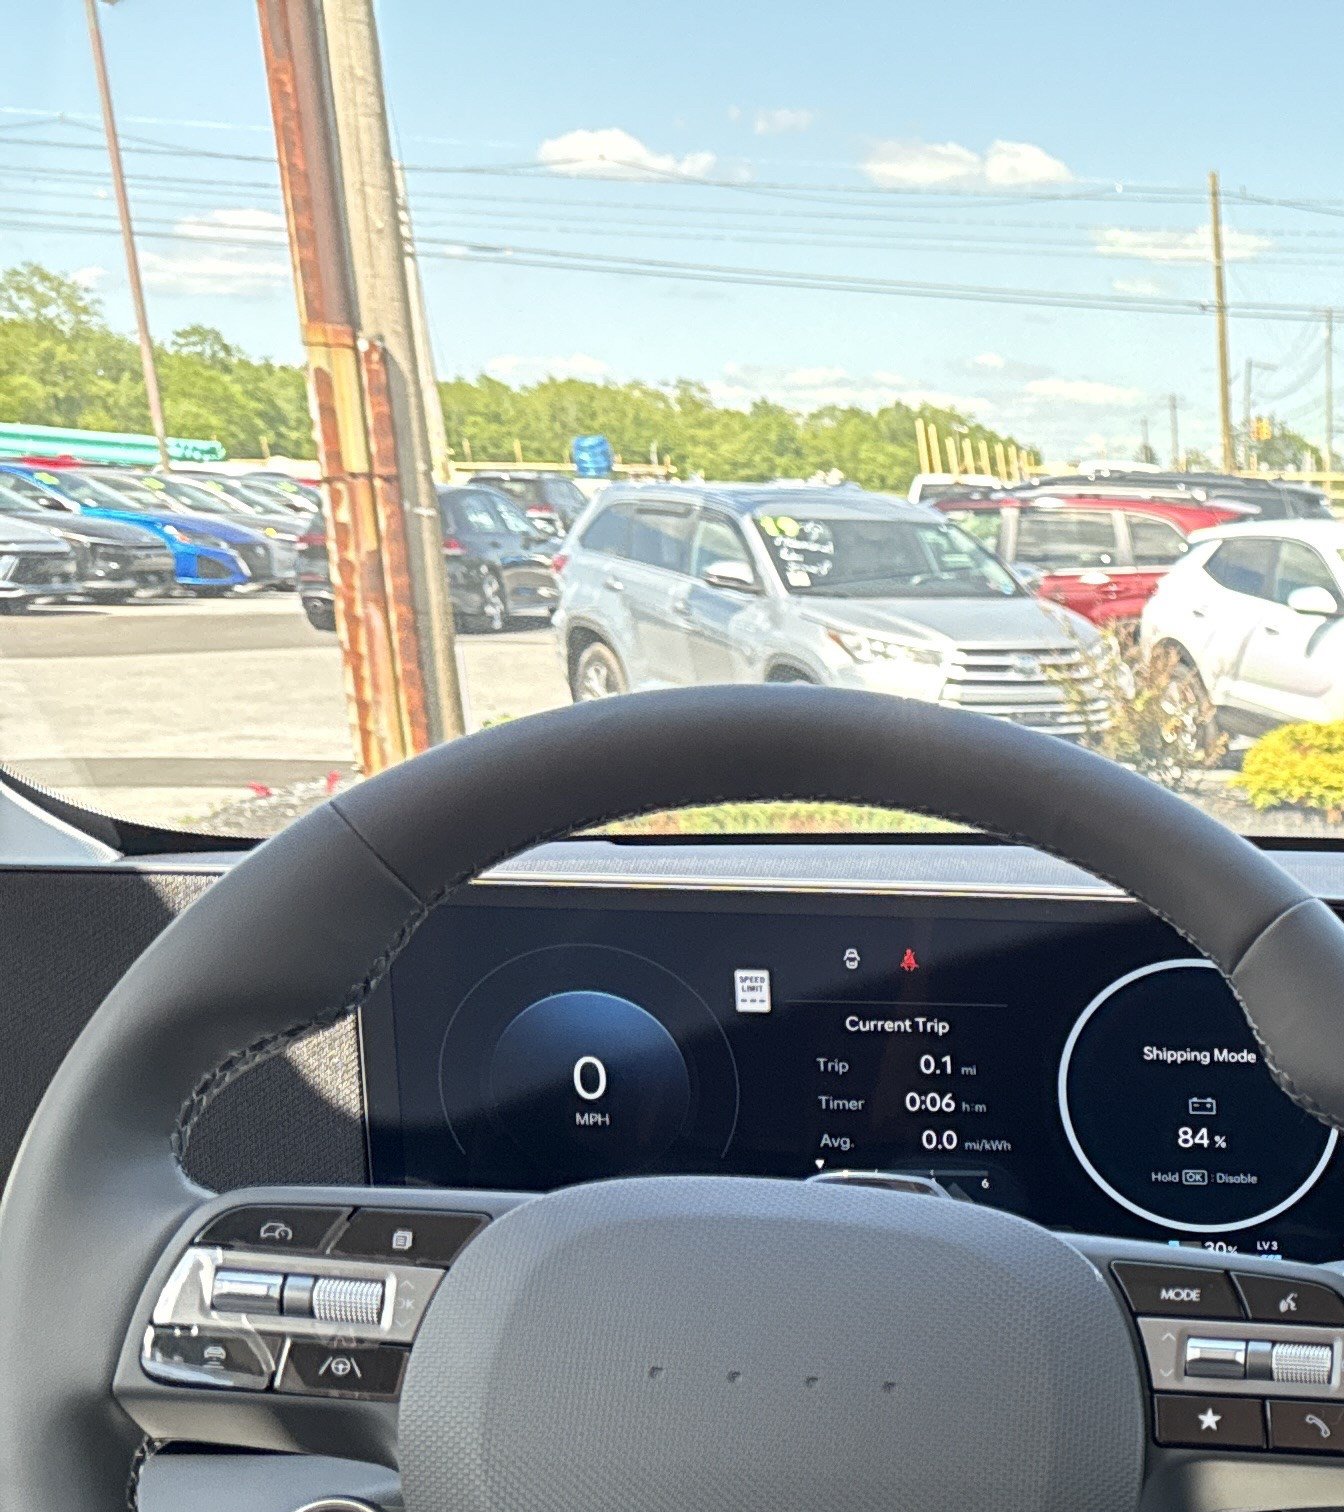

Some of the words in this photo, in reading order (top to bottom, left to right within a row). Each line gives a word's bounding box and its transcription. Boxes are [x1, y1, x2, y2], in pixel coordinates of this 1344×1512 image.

[845, 1016, 912, 1032] Current
[915, 1018, 950, 1036] Trip
[817, 1058, 849, 1075] Trip
[920, 1055, 952, 1075] 0.1
[961, 1066, 976, 1075] mi
[1143, 1046, 1210, 1065] Shipping
[1214, 1048, 1256, 1063] Mode
[573, 1056, 606, 1100] 0
[819, 1096, 865, 1110] Timer
[905, 1092, 956, 1112] 0:06
[962, 1102, 986, 1112] h:m
[575, 1112, 610, 1126] MPH
[820, 1134, 854, 1151] Avg.
[922, 1130, 957, 1149] 0.0
[965, 1140, 1011, 1151] mi/kWh
[1178, 1129, 1210, 1148] 84
[1215, 1135, 1227, 1148] %
[982, 1179, 989, 1188] 6
[1152, 1171, 1179, 1184] Hold
[1186, 1172, 1203, 1183] OK
[1216, 1173, 1257, 1184] Disable
[1161, 1288, 1200, 1301] MODE
